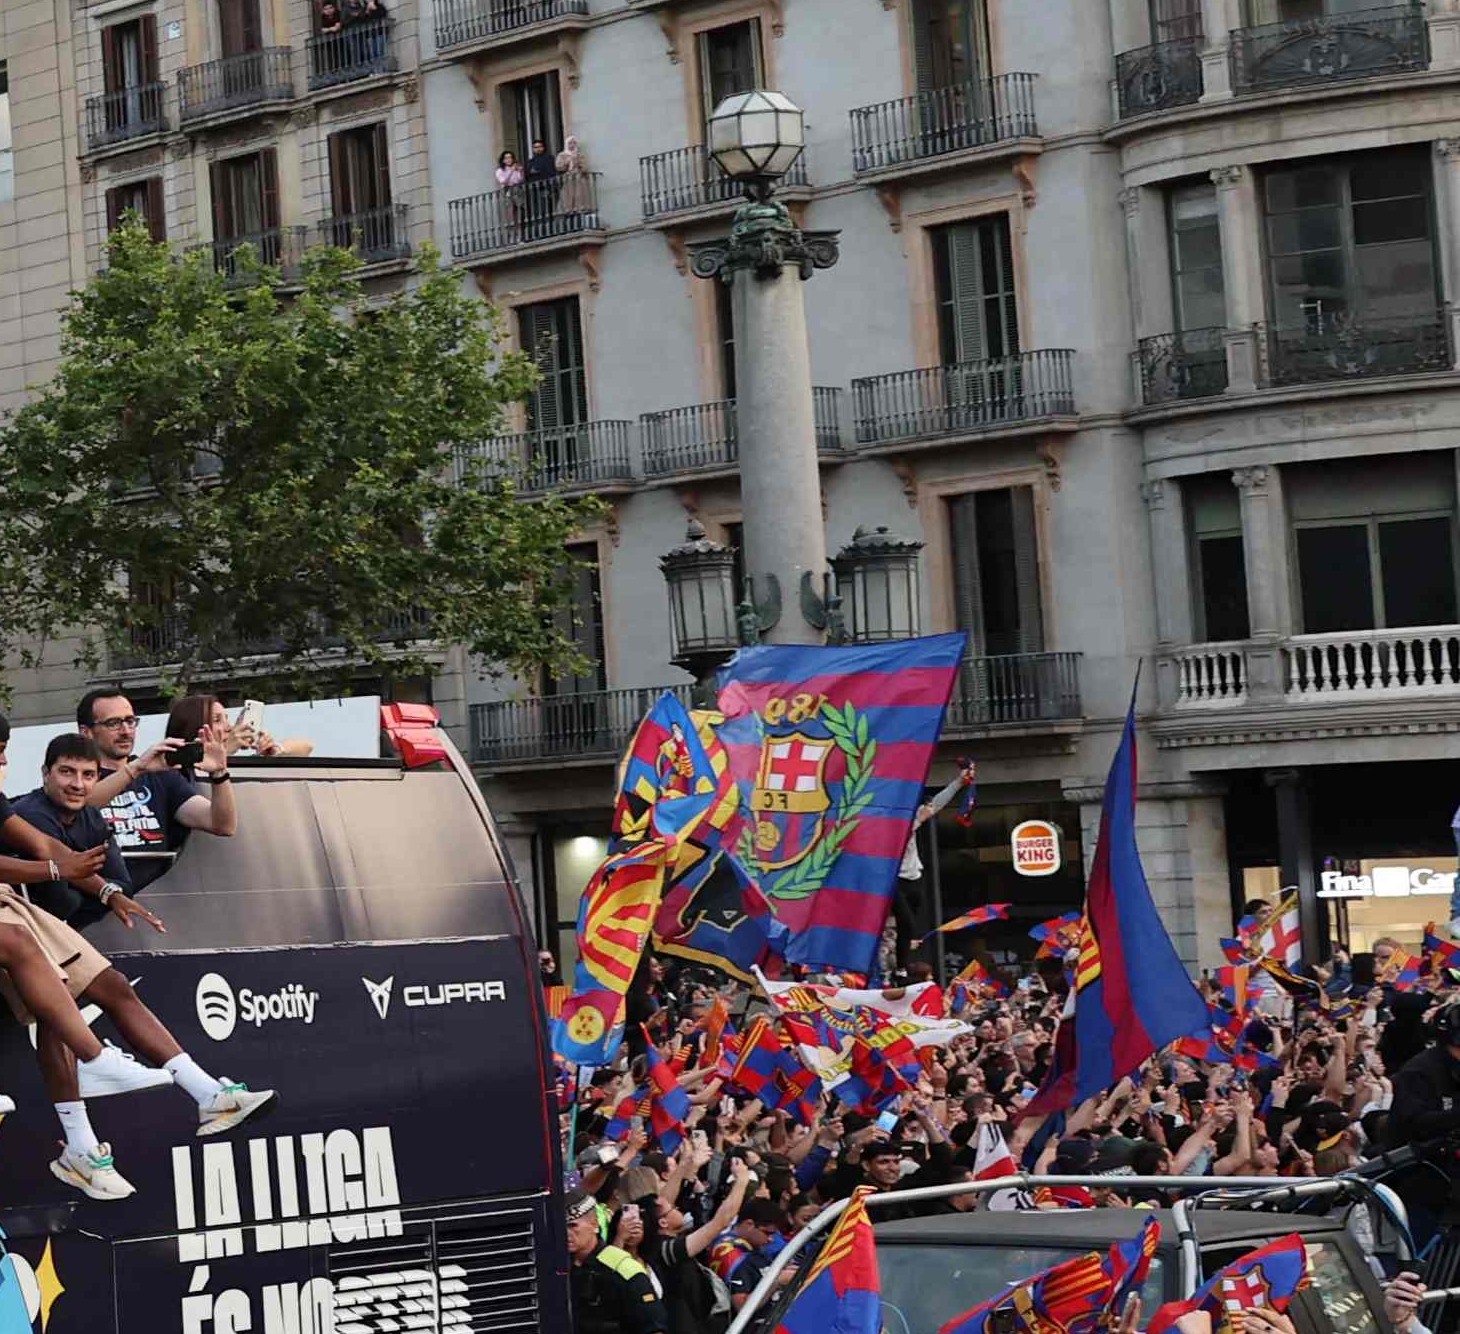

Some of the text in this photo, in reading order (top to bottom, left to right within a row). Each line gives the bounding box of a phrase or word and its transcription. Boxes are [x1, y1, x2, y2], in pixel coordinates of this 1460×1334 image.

[1016, 839, 1054, 848] BURGER
[1016, 848, 1055, 862] KING
[239, 983, 317, 1027] Spotify
[403, 980, 506, 1007] CUPRA
[171, 1125, 404, 1263] LA LLIGA
